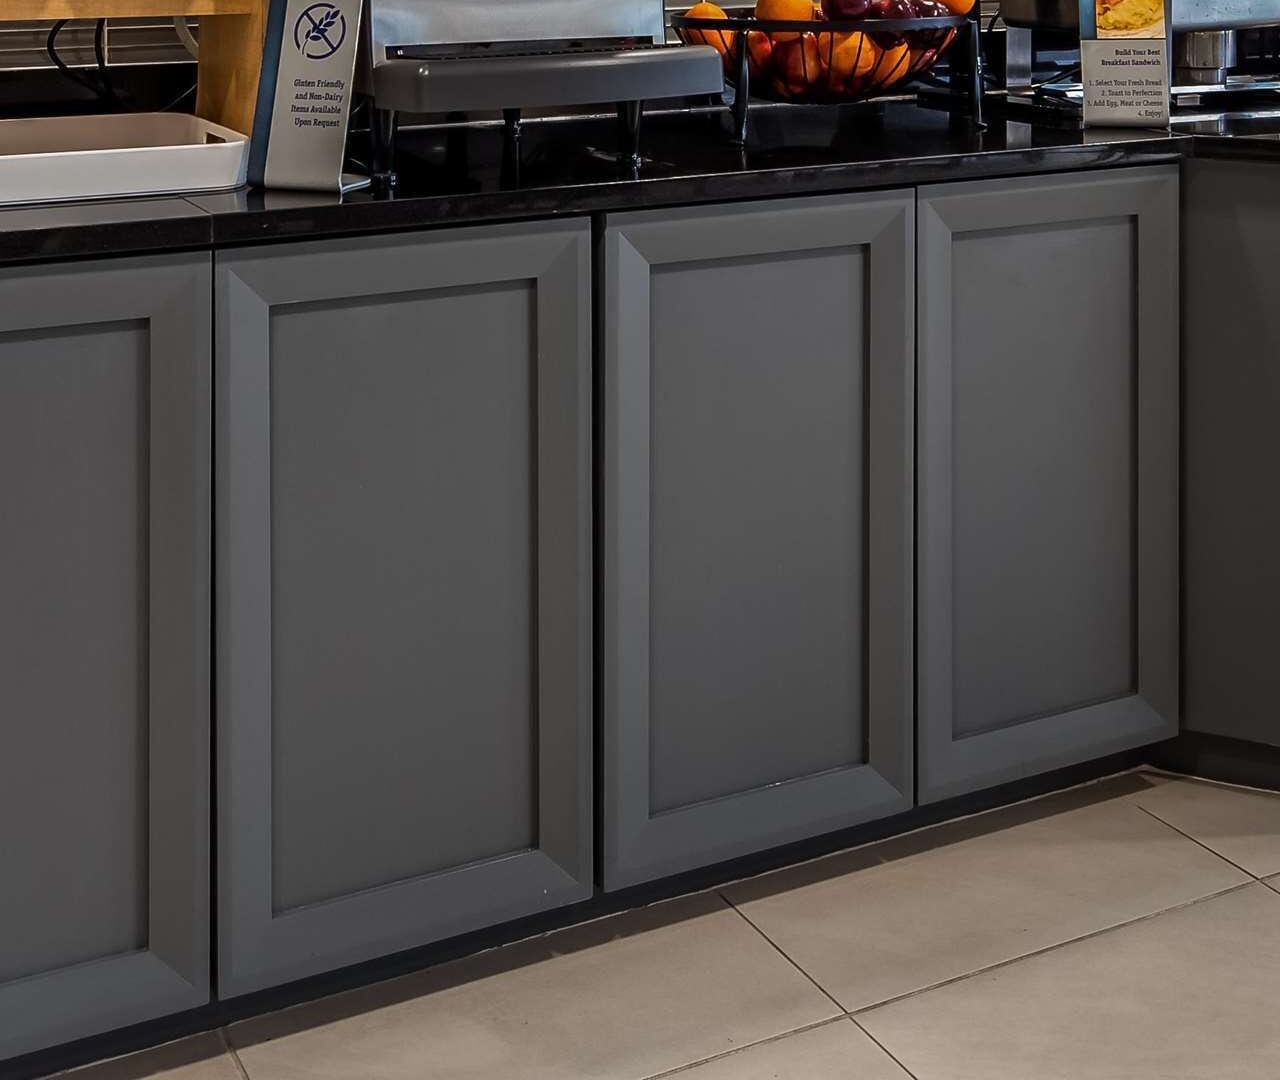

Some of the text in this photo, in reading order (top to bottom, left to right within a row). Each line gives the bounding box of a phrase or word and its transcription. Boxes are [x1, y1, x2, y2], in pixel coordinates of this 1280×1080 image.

[294, 79, 344, 90] Gluten Friendly
[309, 92, 343, 103] Non-Dairy
[291, 104, 341, 113] Items Available
[294, 118, 340, 128] Upon Request
